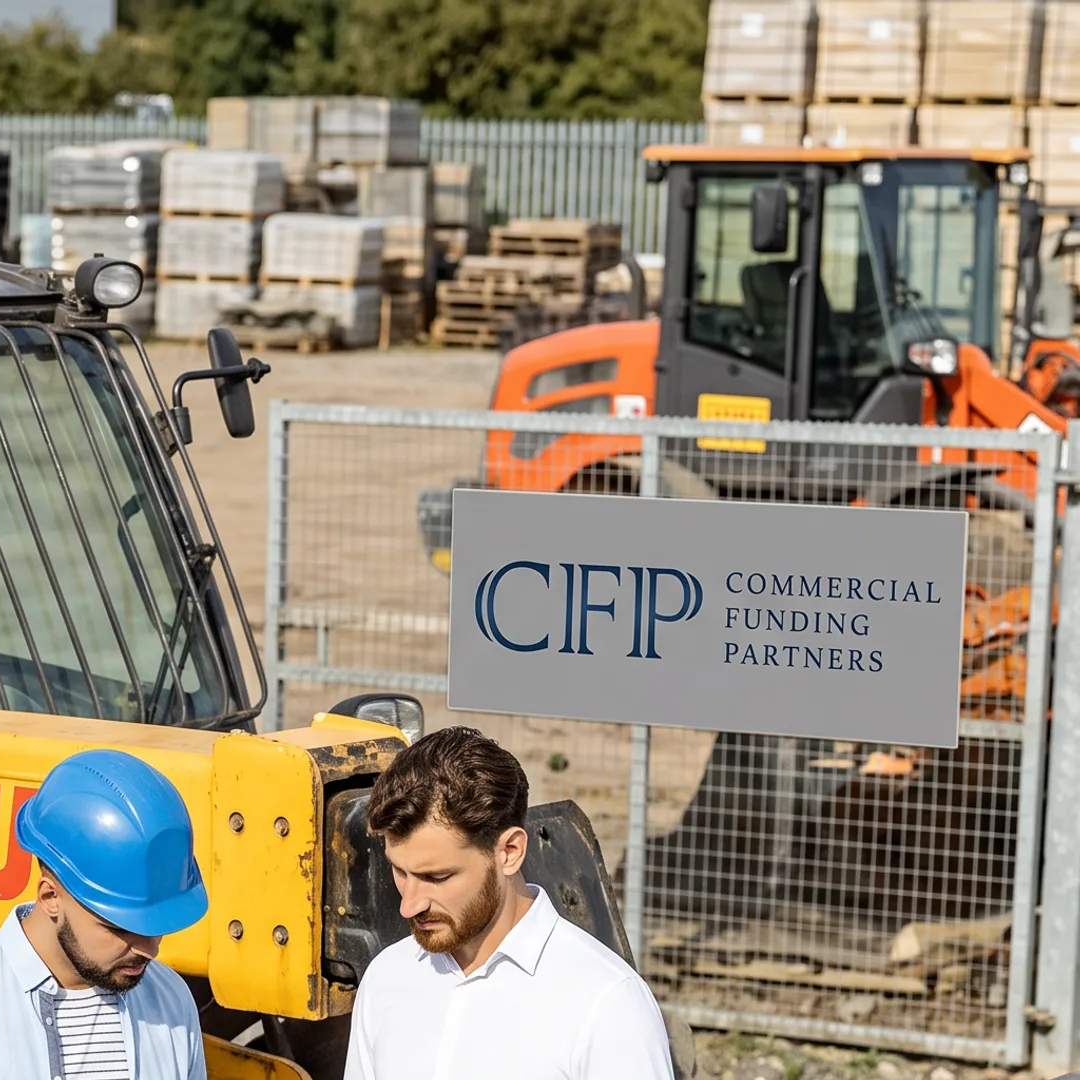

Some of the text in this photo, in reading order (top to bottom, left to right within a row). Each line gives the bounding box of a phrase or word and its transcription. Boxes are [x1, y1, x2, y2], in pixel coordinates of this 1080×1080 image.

[725, 571, 942, 604] COMMERCIAL
[474, 560, 704, 659] CFP
[724, 607, 871, 637] FUNDING
[723, 642, 884, 673] PARTNERS
